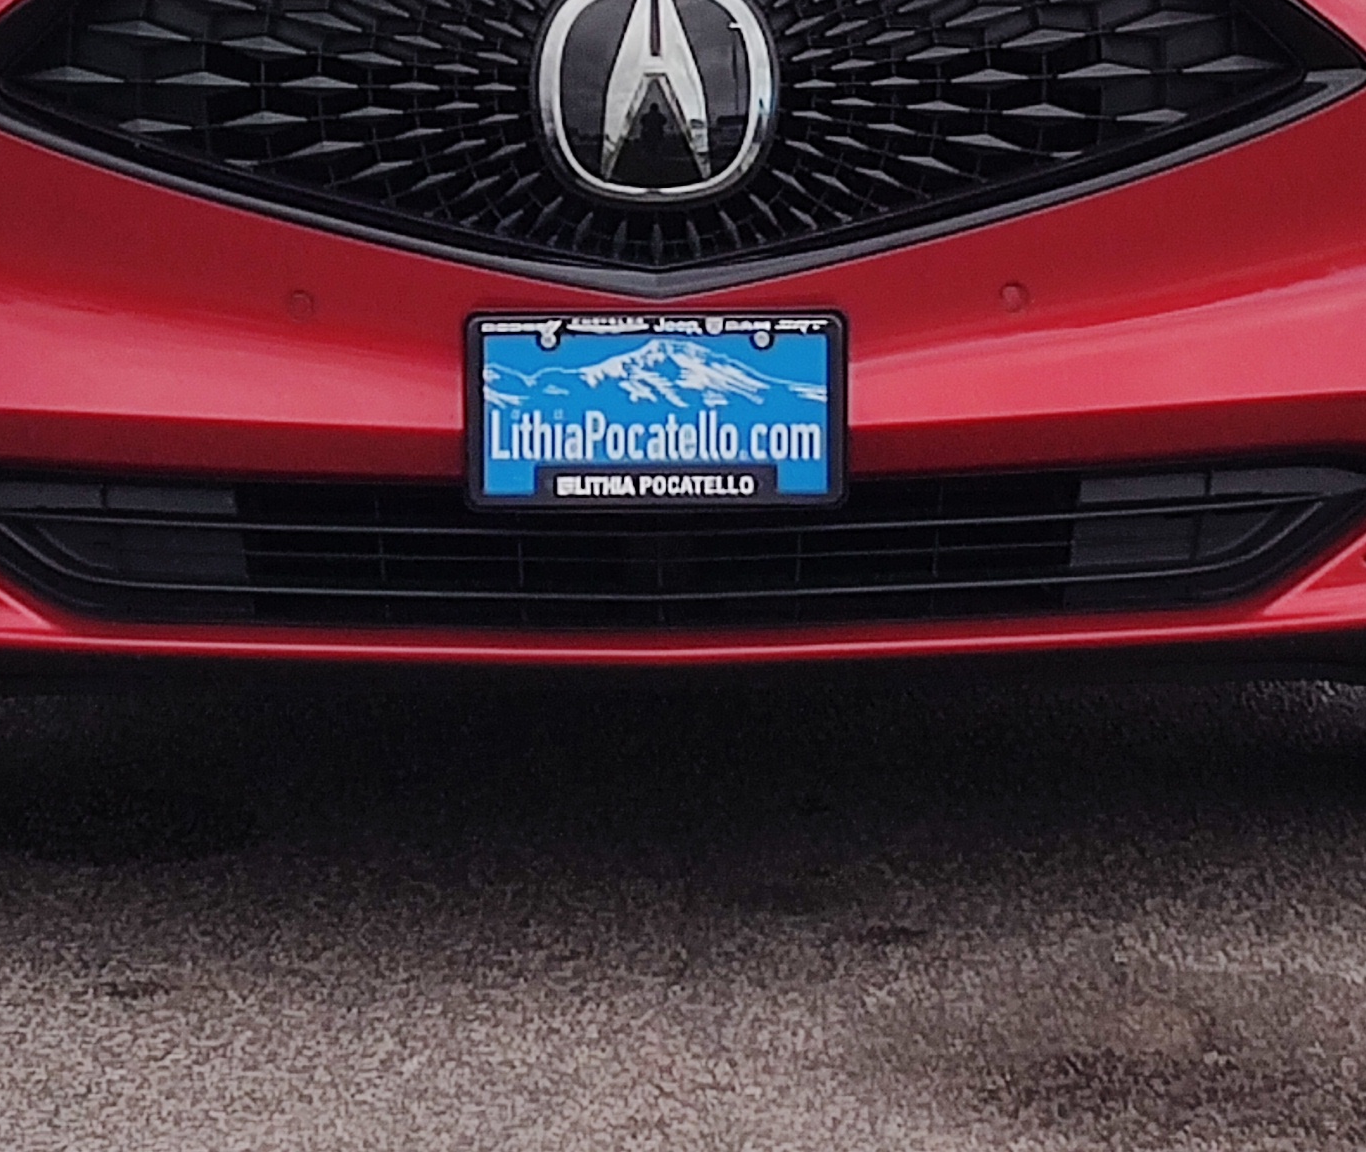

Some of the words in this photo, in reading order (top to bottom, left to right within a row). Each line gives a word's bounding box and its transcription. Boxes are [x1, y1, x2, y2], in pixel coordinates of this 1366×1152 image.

[490, 409, 822, 461] LithiaPocatello.com
[577, 476, 635, 497] LITHIA
[639, 476, 755, 497] POCATELLO
